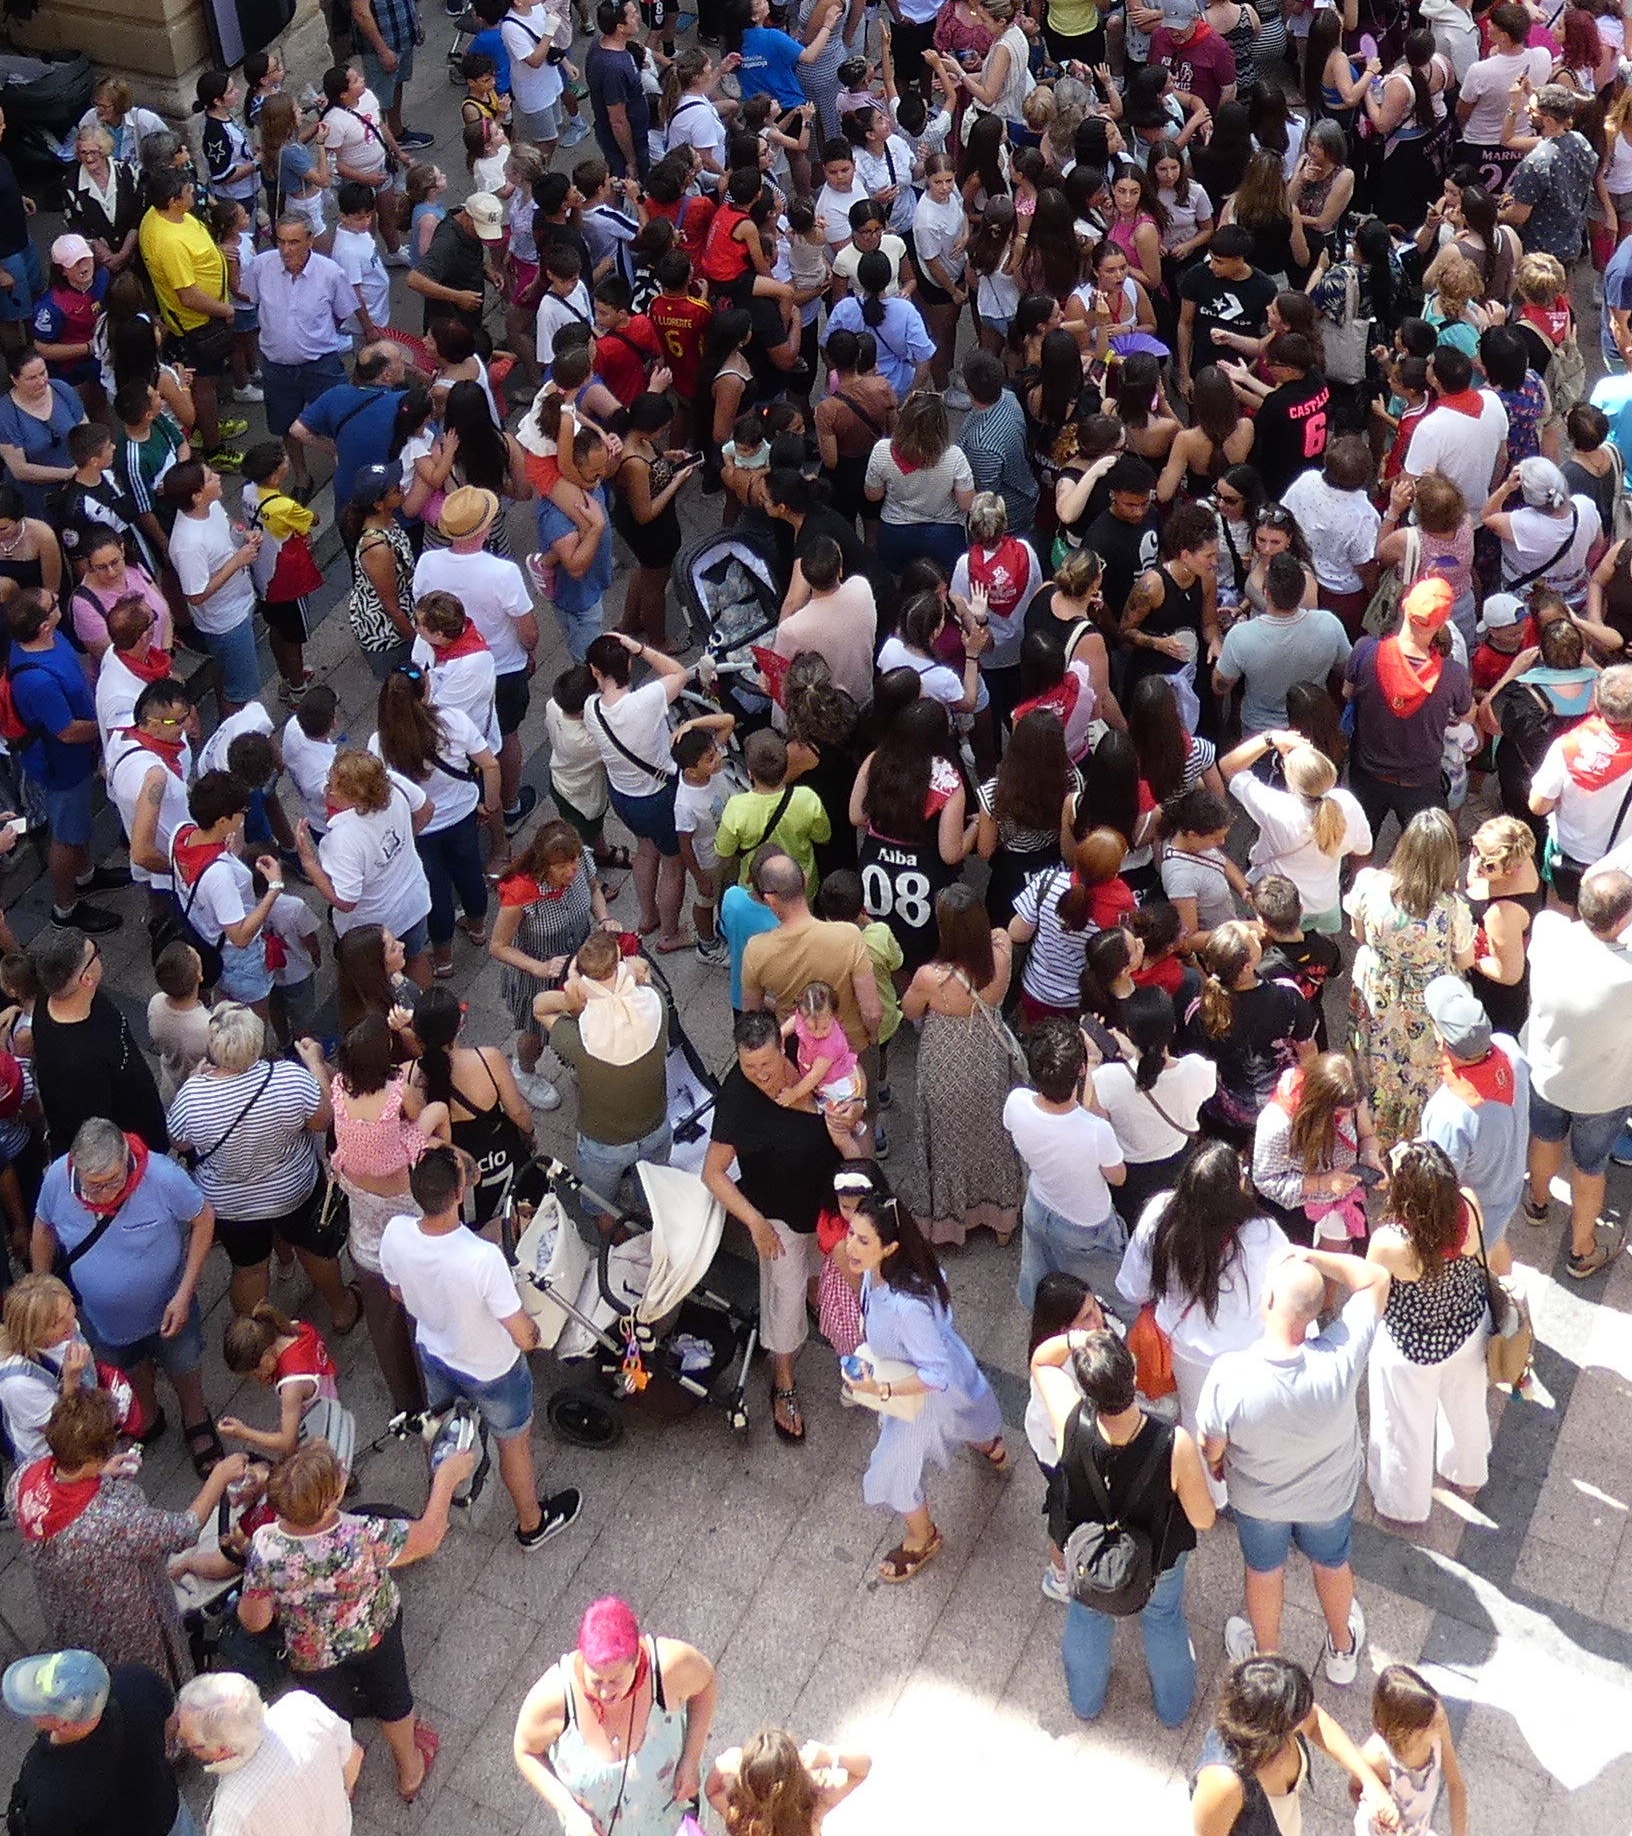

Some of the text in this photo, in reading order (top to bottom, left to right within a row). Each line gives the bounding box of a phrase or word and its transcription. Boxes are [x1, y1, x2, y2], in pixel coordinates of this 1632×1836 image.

[655, 1, 663, 15] 8
[665, 330, 684, 358] 6
[1304, 412, 1326, 458] 6
[876, 848, 917, 866] Alba
[860, 864, 931, 928] 08
